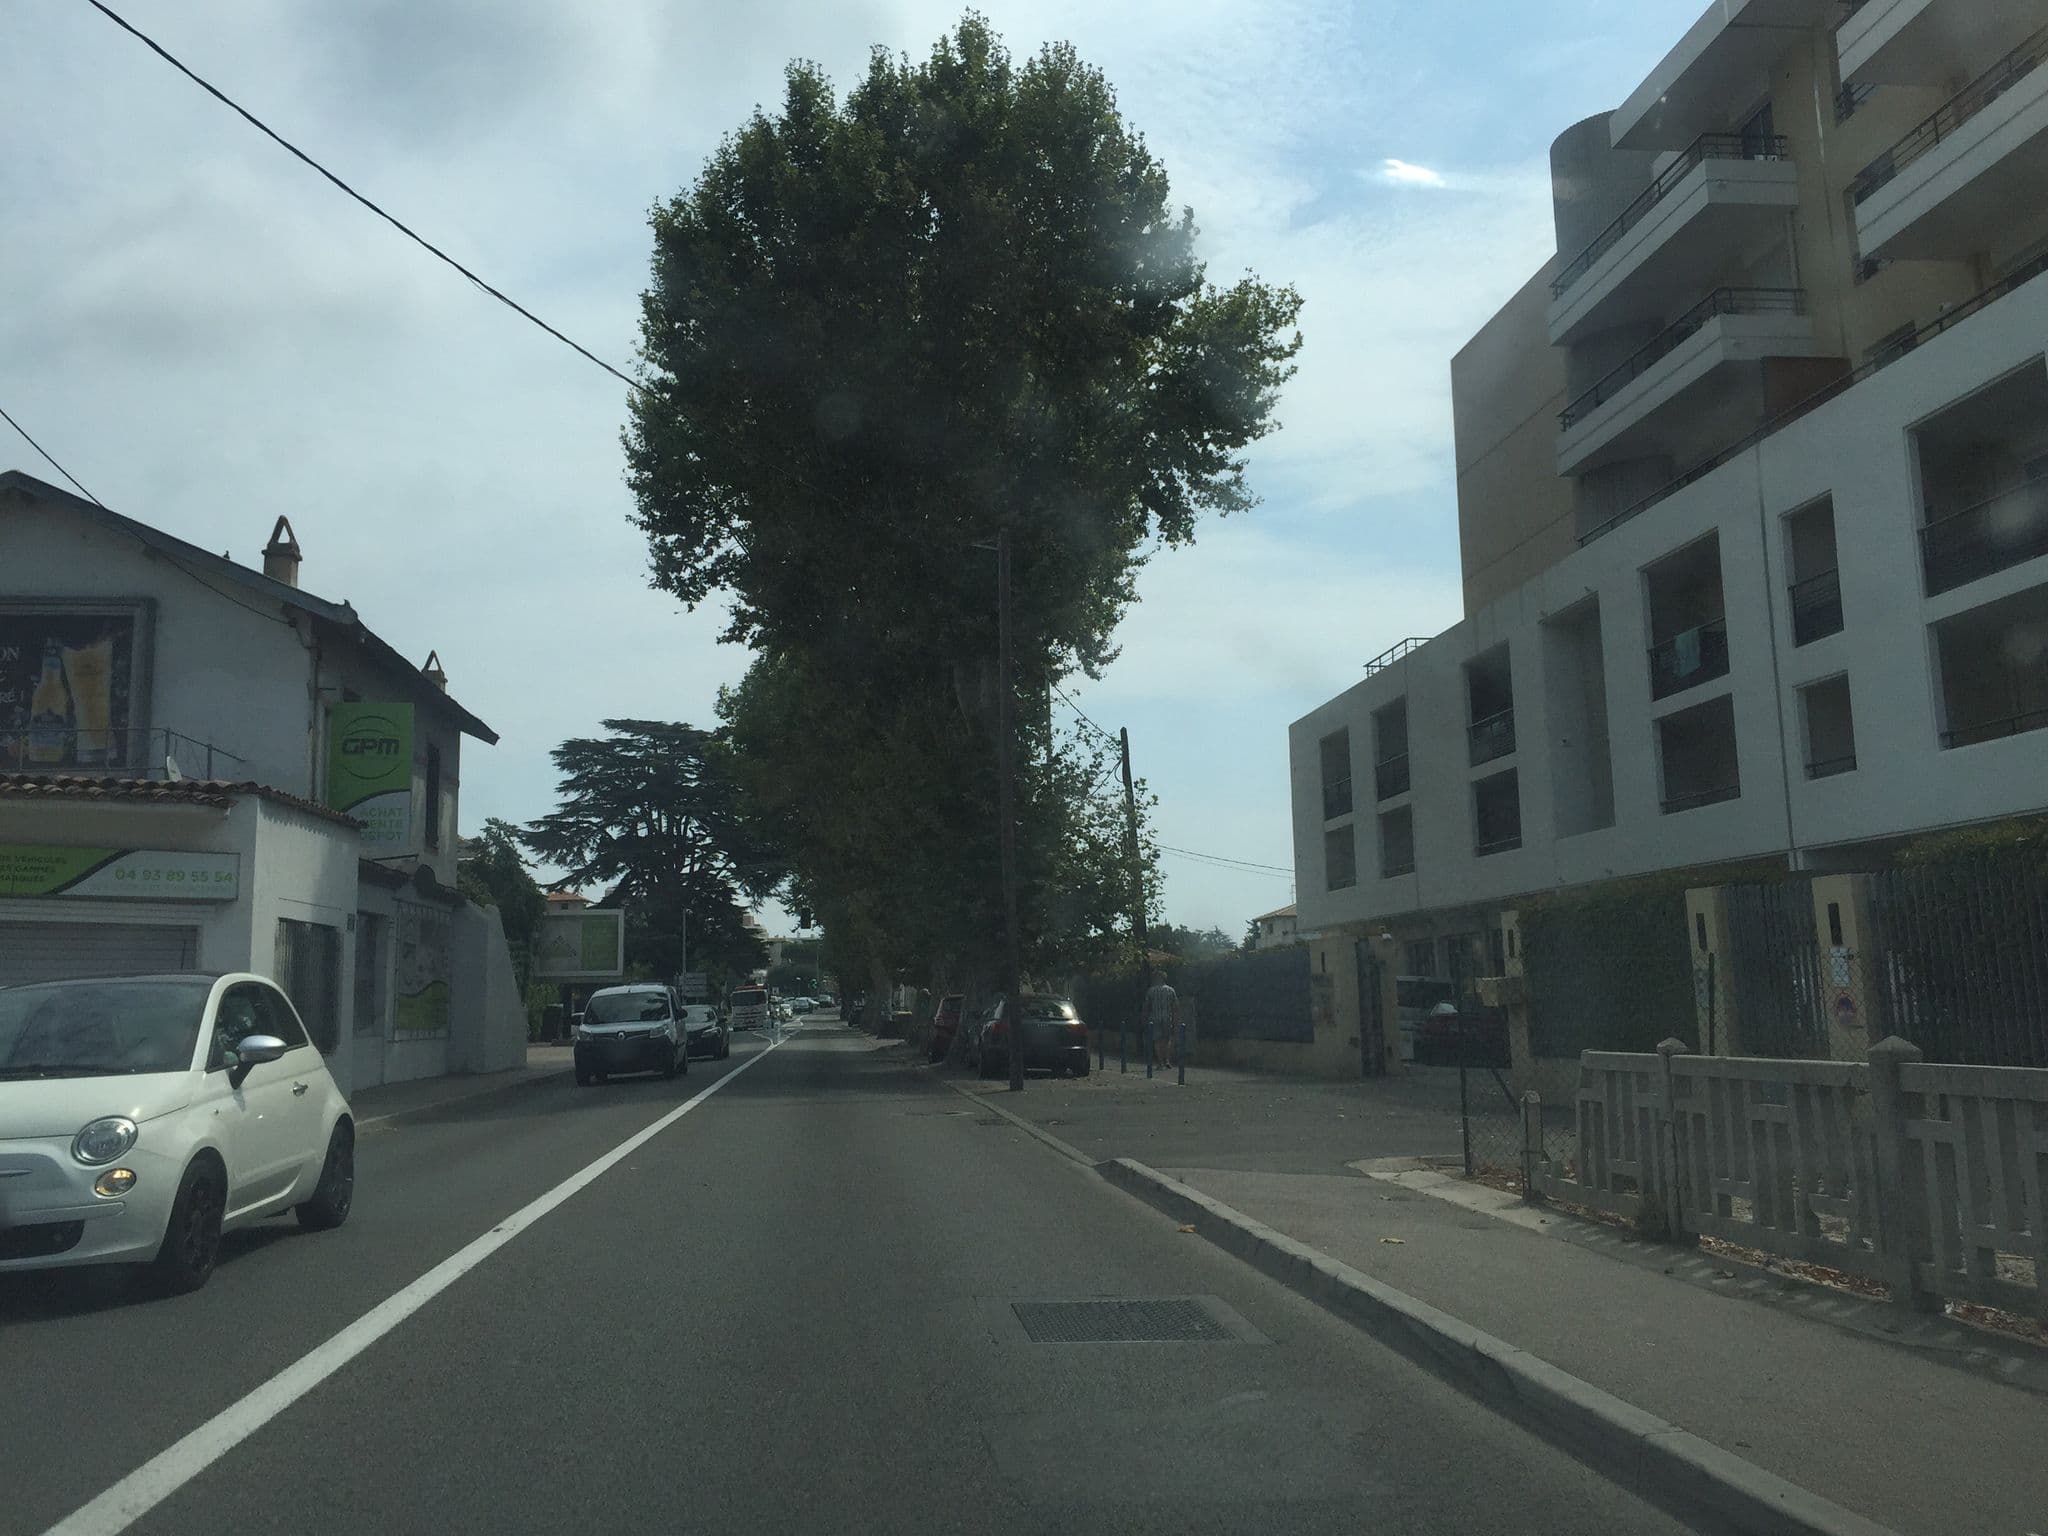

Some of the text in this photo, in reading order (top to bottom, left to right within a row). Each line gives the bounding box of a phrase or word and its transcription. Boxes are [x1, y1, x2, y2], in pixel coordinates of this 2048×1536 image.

[361, 807, 403, 817] ACHAT
[115, 869, 137, 881] 04
[142, 870, 161, 881] 93
[191, 871, 209, 882] 55
[214, 871, 234, 883] 54
